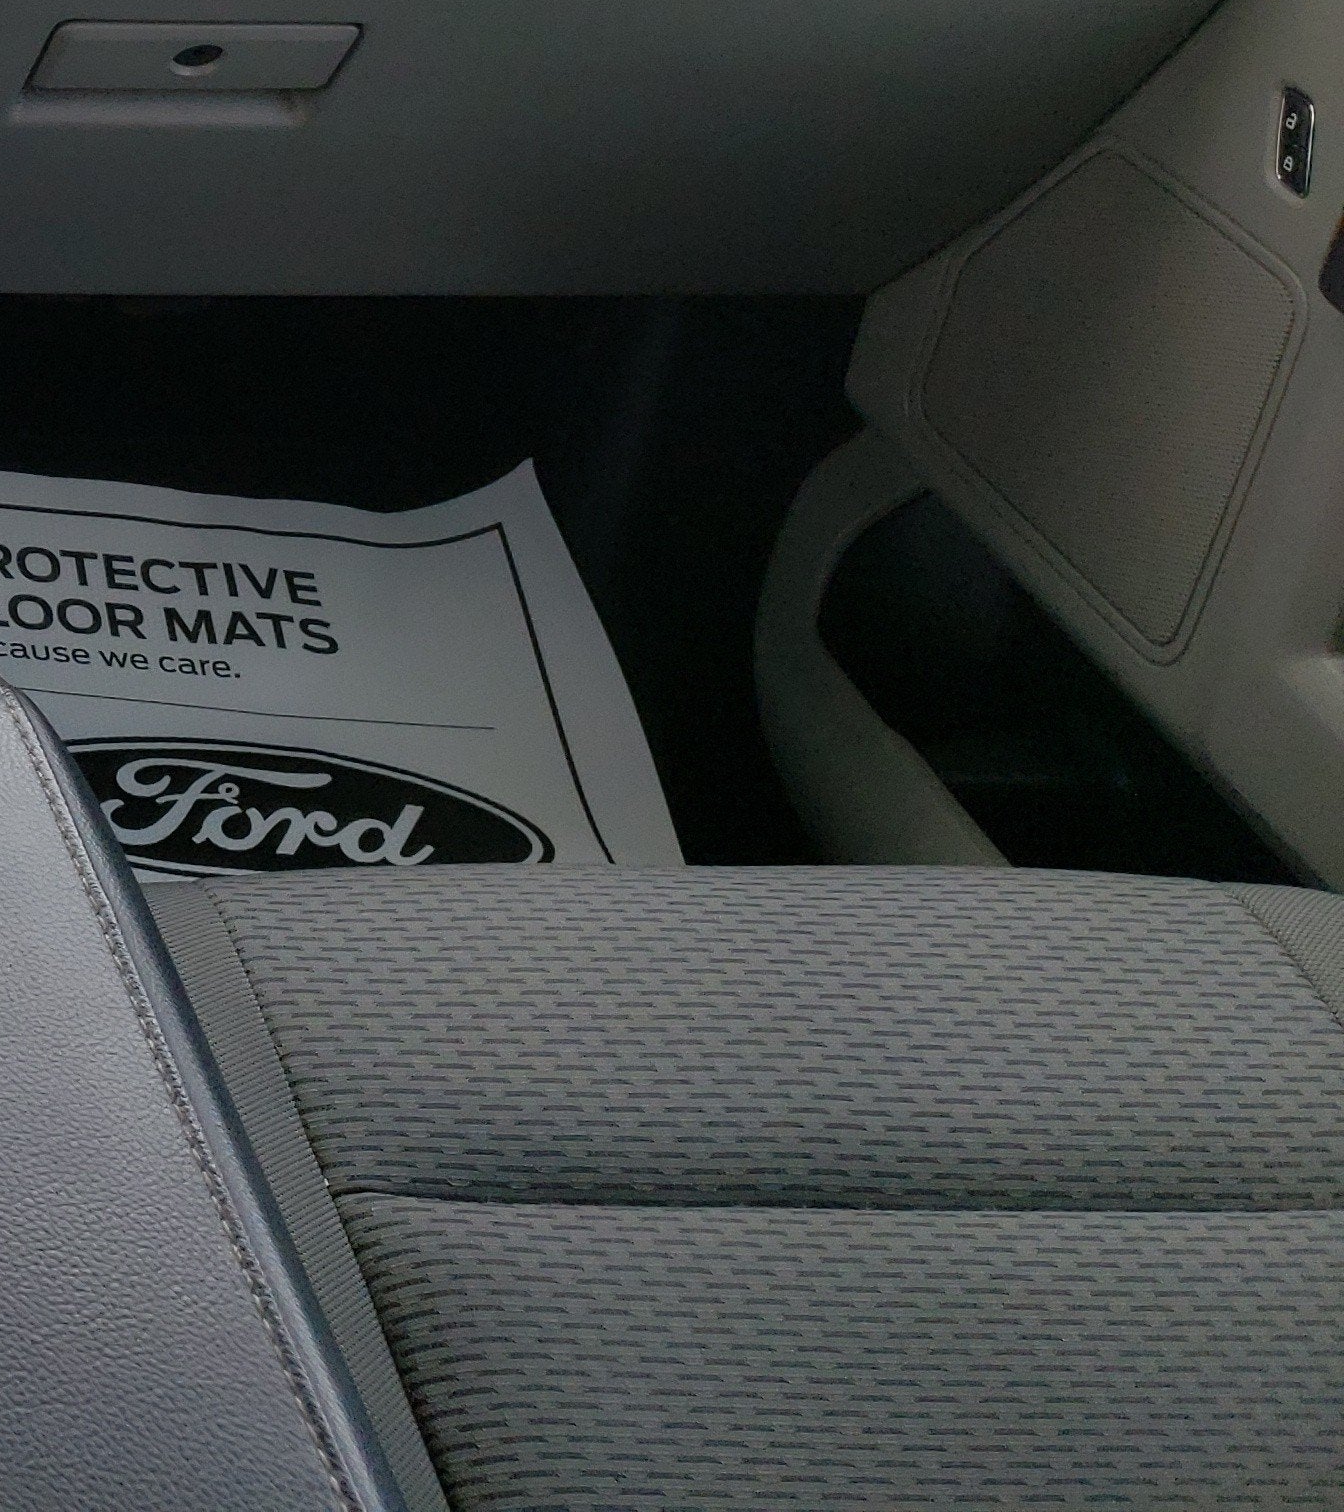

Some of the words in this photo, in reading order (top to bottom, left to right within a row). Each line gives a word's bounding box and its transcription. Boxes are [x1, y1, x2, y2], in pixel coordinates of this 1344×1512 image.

[163, 605, 340, 656] MATS
[97, 648, 149, 671] we
[158, 652, 242, 680] care.
[101, 757, 437, 867] Ford
